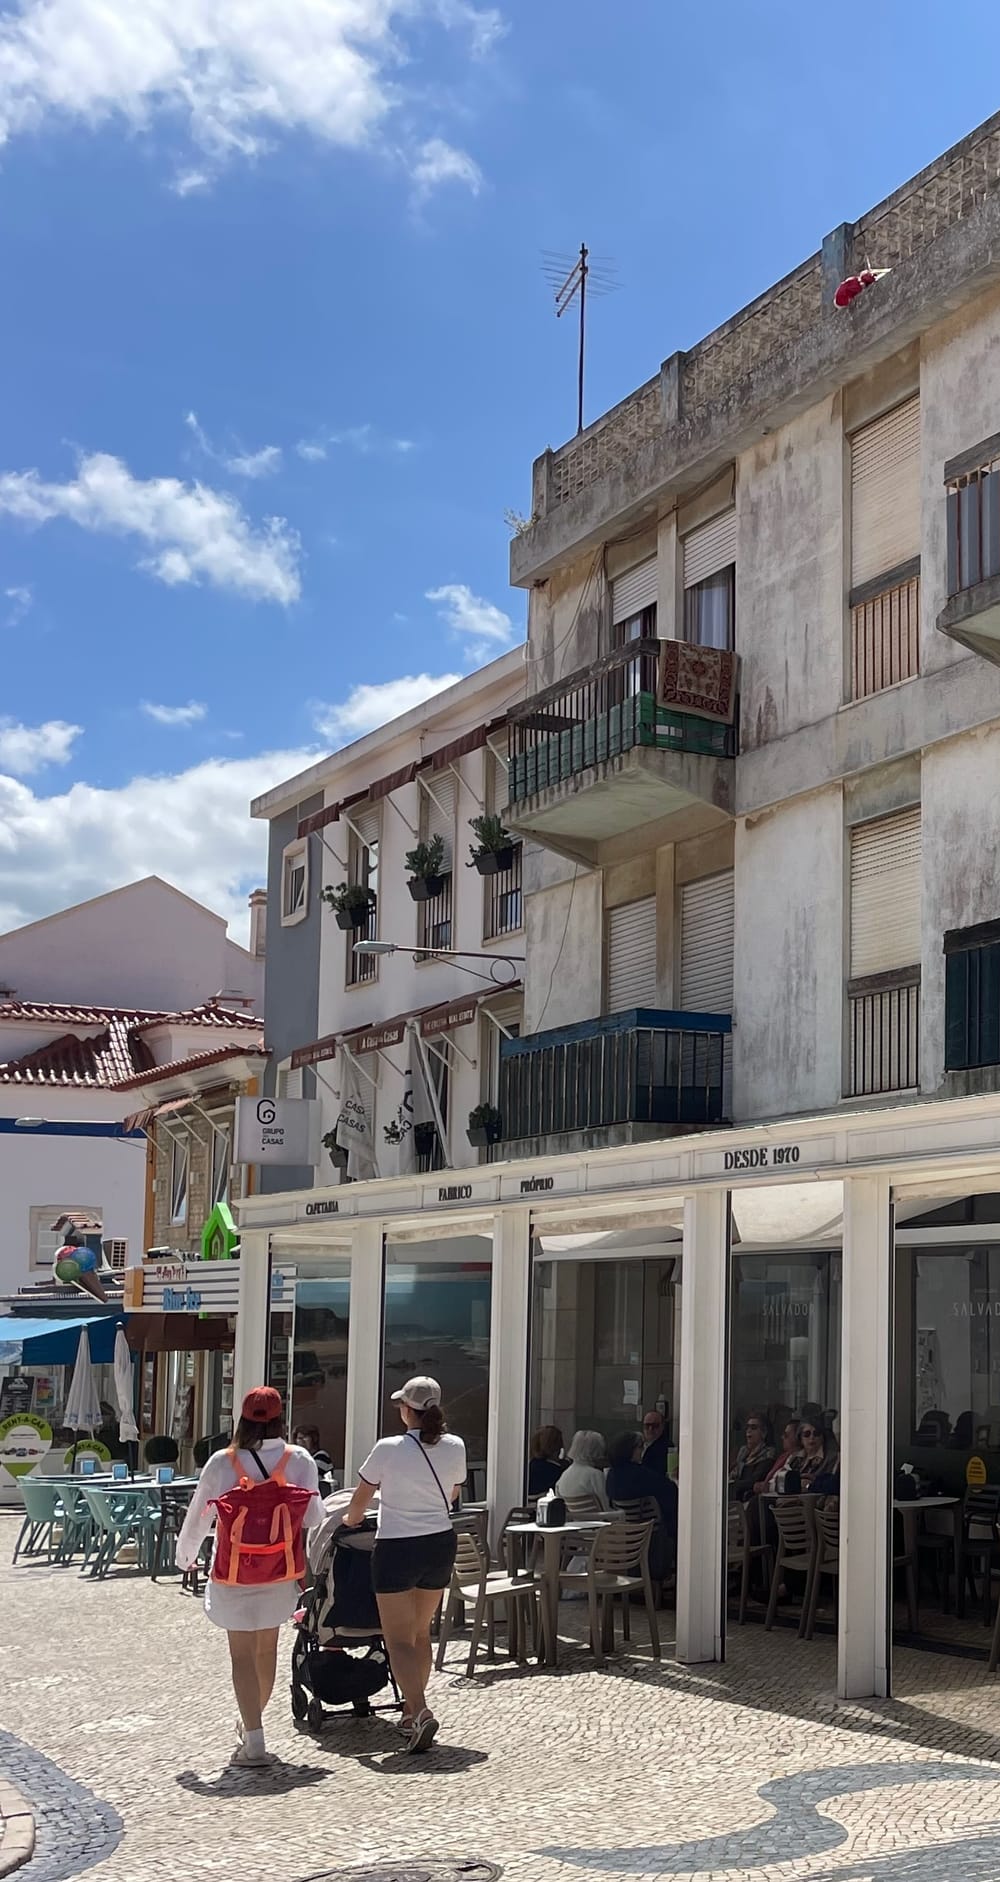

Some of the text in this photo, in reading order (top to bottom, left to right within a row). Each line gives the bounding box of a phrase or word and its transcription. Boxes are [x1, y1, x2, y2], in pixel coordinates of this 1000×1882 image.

[724, 1146, 800, 1170] DESDE 1970
[438, 1184, 472, 1201] FABRICO
[520, 1176, 554, 1193] PRÓPRIO
[762, 1303, 816, 1317] SALVADOR
